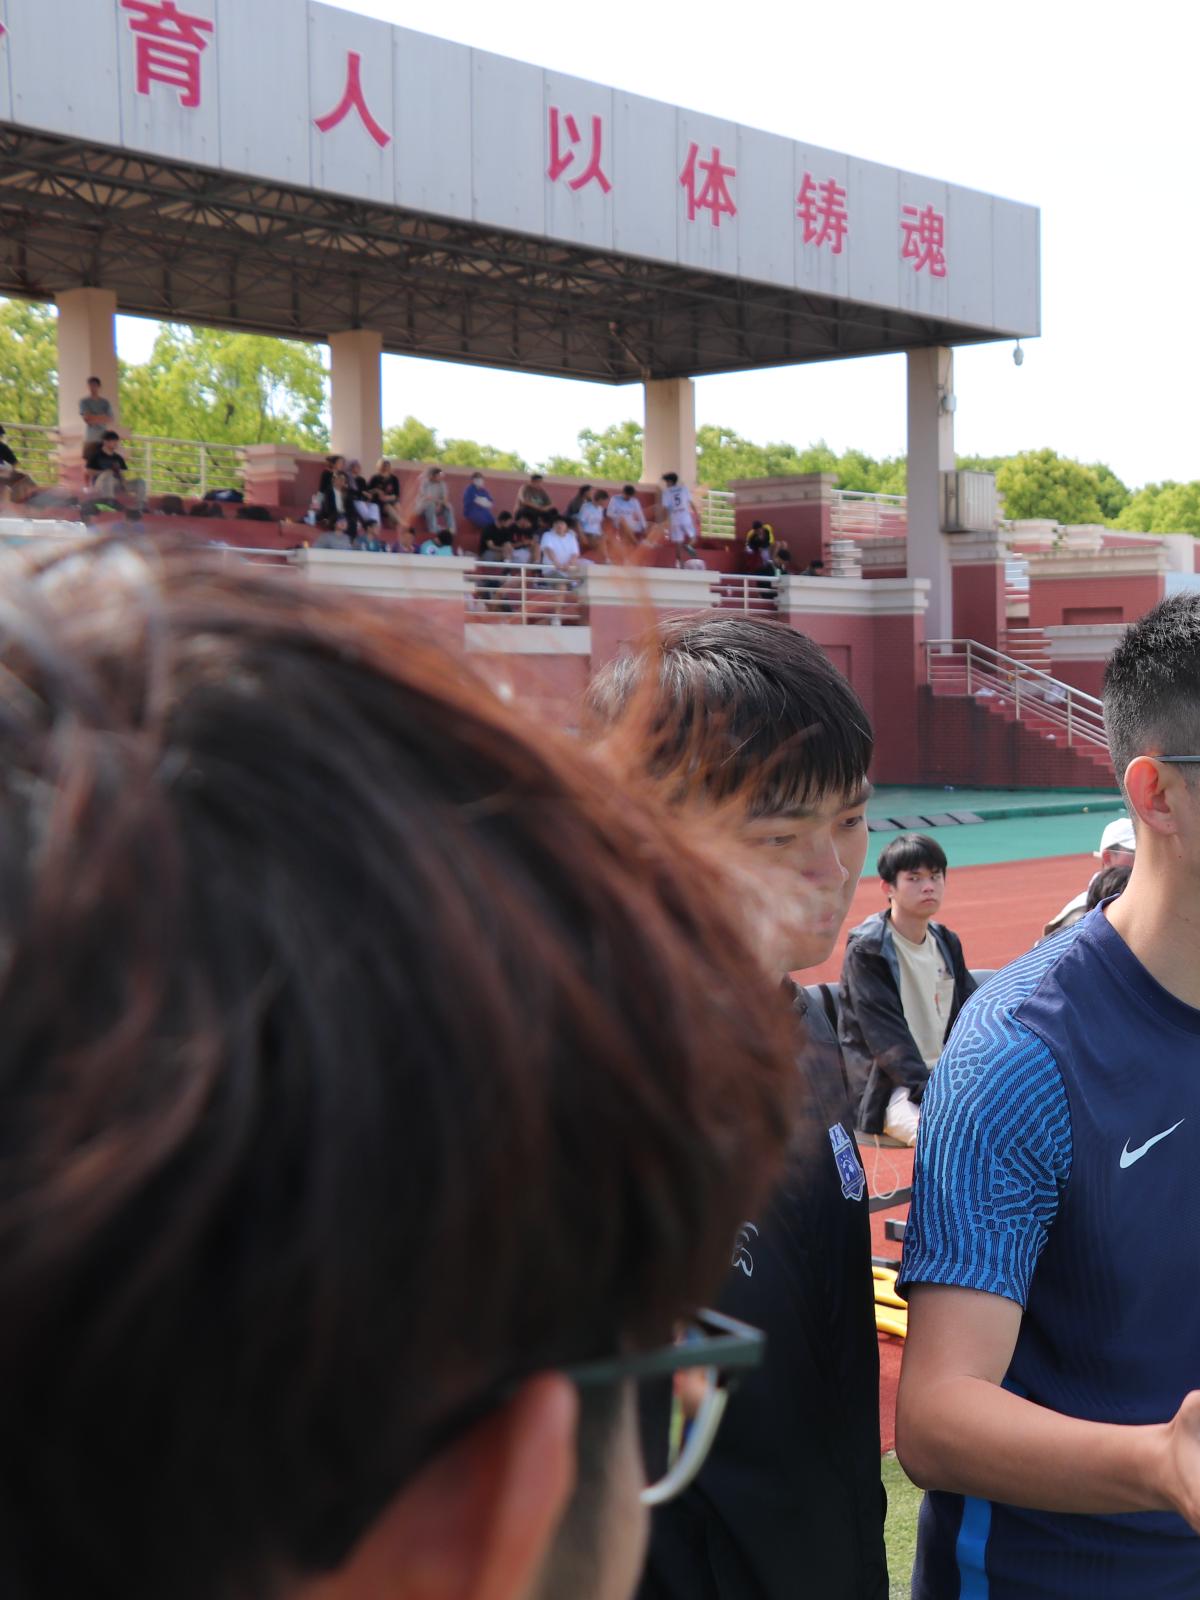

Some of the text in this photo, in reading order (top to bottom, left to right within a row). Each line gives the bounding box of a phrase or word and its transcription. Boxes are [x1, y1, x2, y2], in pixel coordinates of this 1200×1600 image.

[547, 105, 947, 279] 以体铸魂
[830, 1124, 849, 1149] FA
